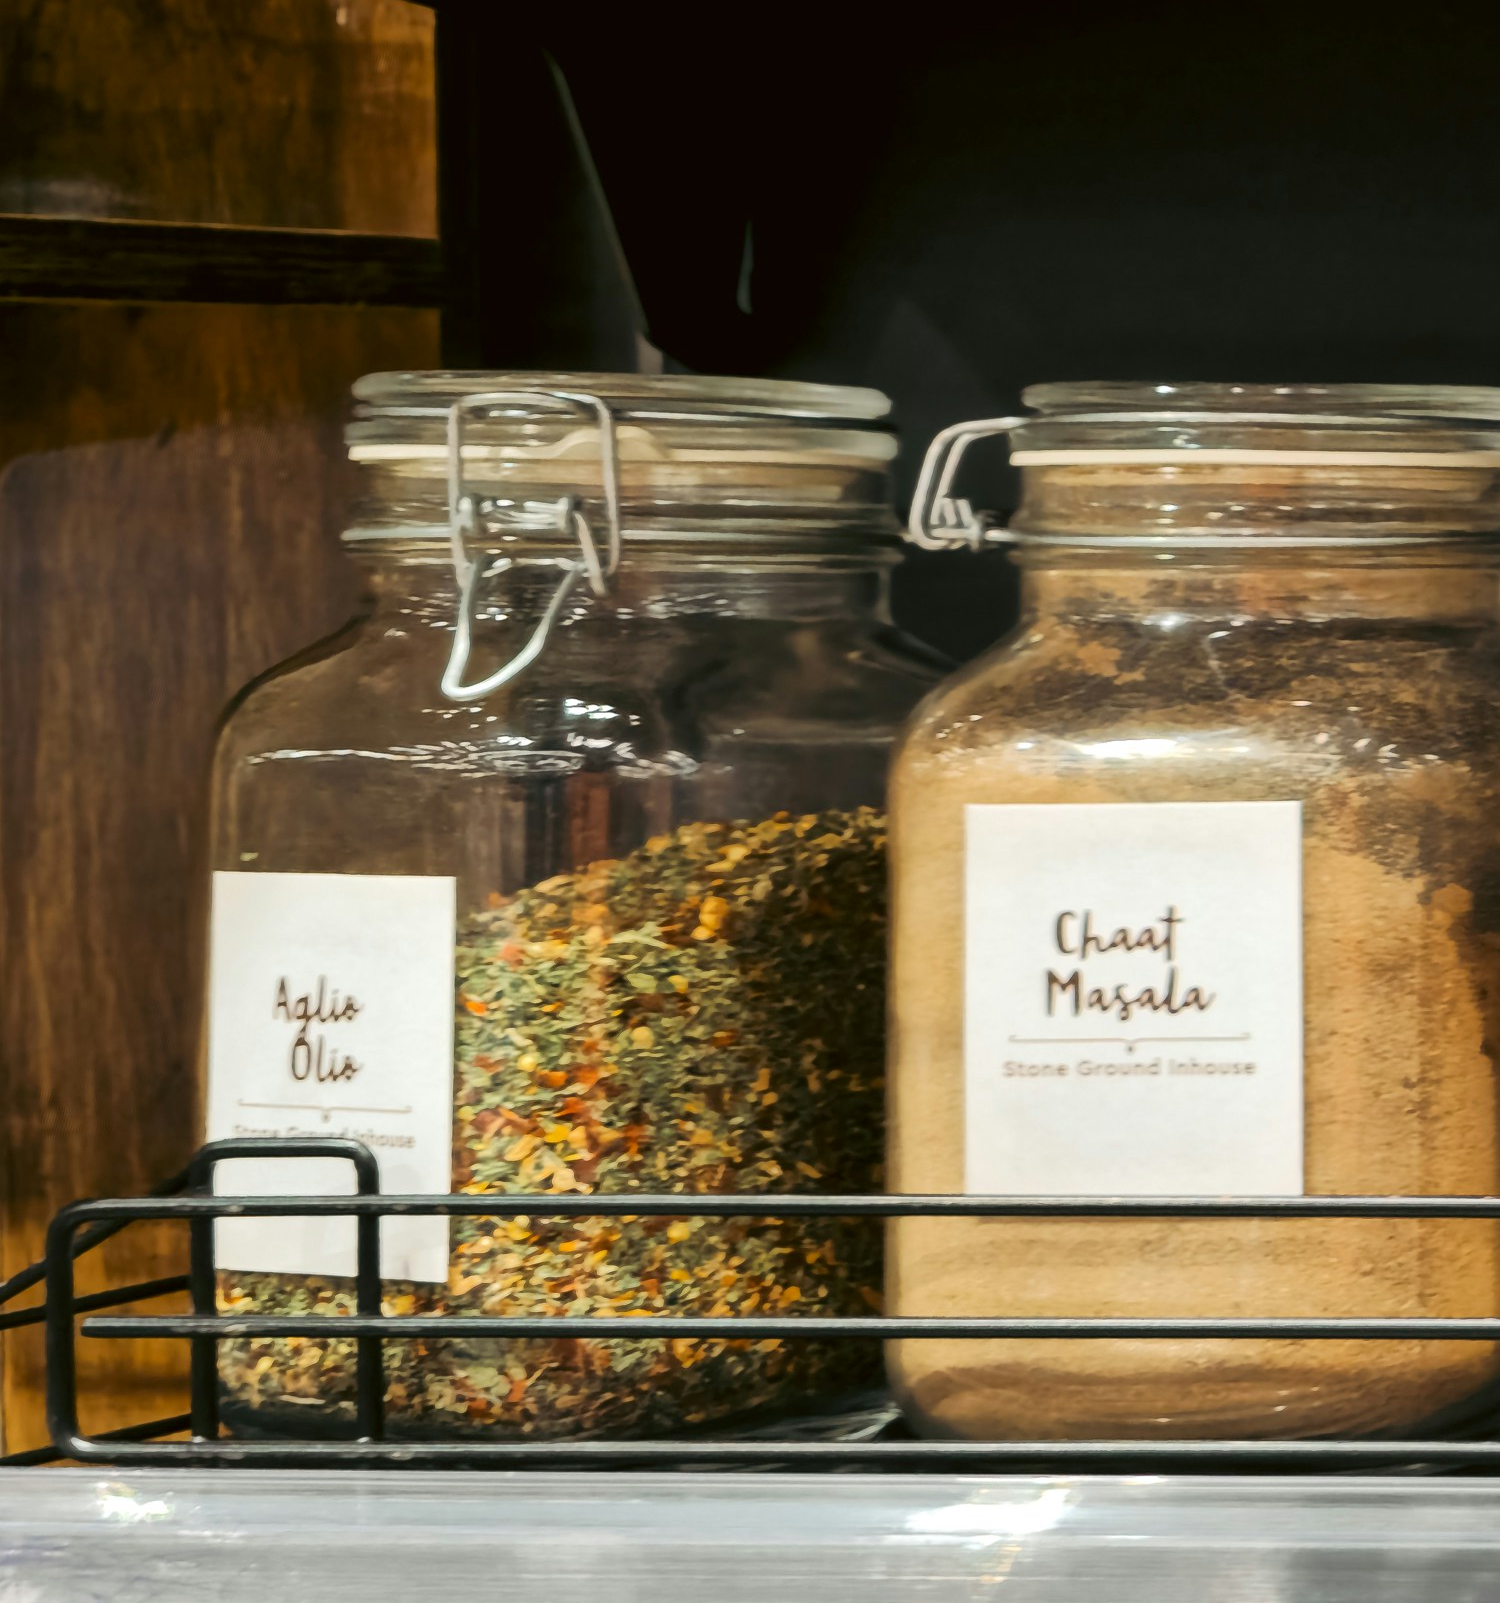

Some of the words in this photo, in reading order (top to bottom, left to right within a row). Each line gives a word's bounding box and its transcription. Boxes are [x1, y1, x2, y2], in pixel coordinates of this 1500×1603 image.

[1053, 906, 1184, 962] Chaat
[273, 976, 363, 1037] Aglio
[1045, 967, 1215, 1022] Masala
[290, 1035, 362, 1083] Olio
[1003, 1061, 1069, 1078] Stone
[1076, 1059, 1161, 1077] Ground
[1168, 1058, 1257, 1076] Inhouse
